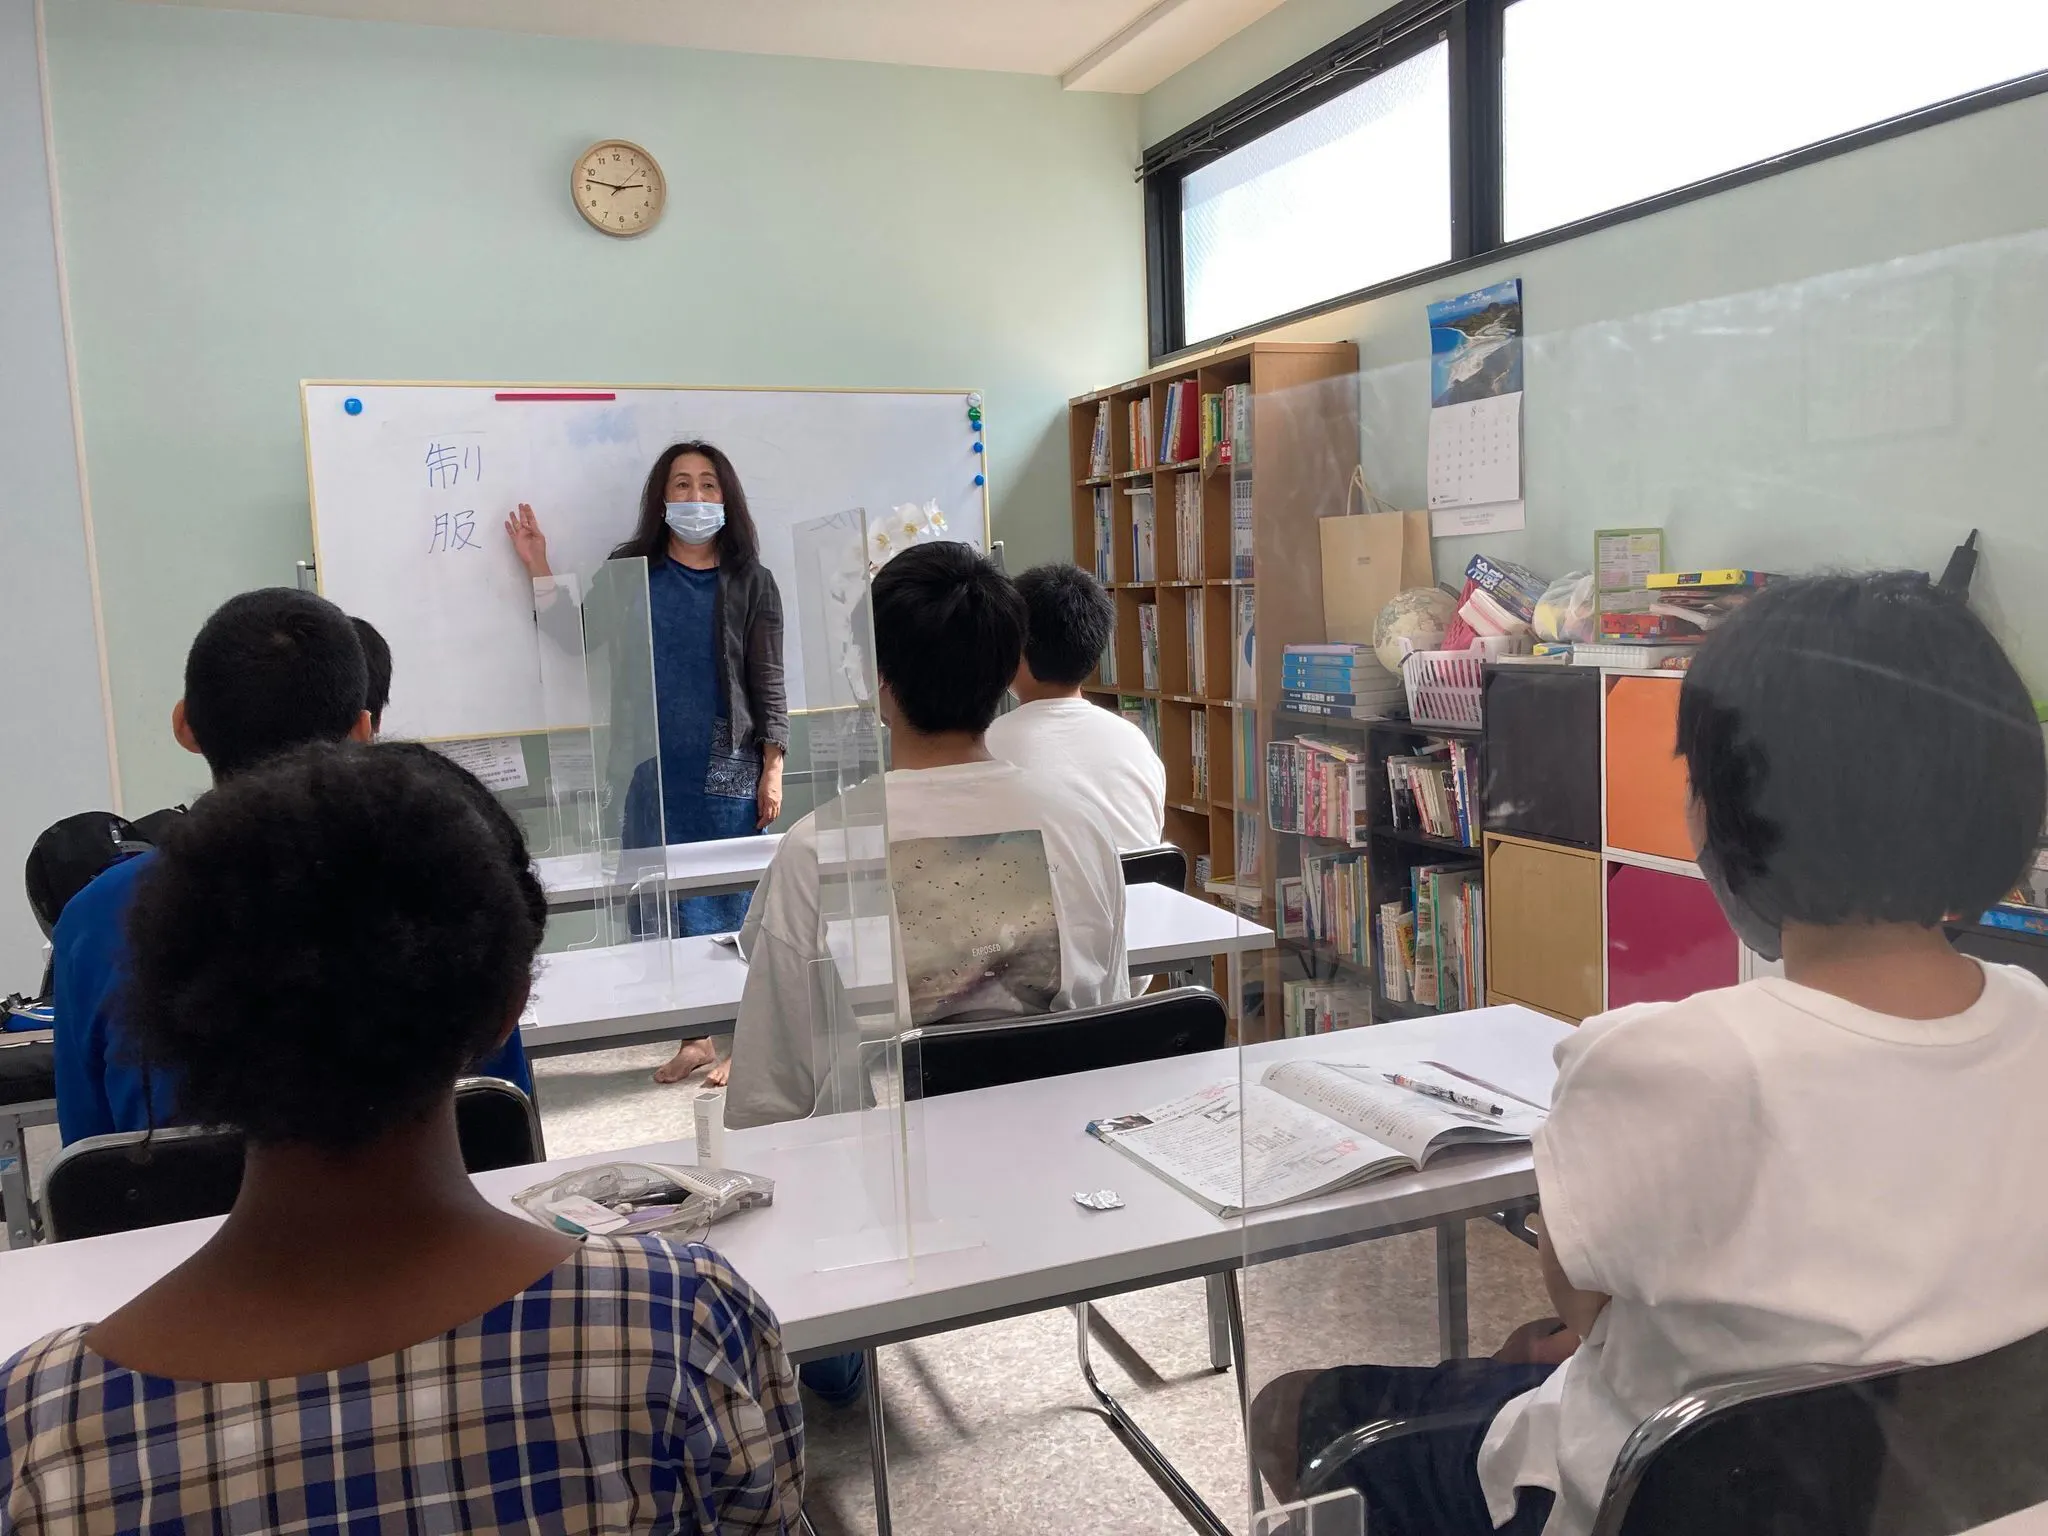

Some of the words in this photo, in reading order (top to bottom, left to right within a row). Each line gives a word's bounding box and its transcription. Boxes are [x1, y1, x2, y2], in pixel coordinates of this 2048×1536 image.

[612, 153, 621, 162] 12
[630, 158, 634, 166] 1
[588, 168, 596, 176] 10
[641, 170, 647, 178] 2
[646, 185, 652, 193] 3
[619, 215, 625, 223] 6
[634, 211, 640, 219] 5
[972, 943, 1001, 957] EXPOSED
